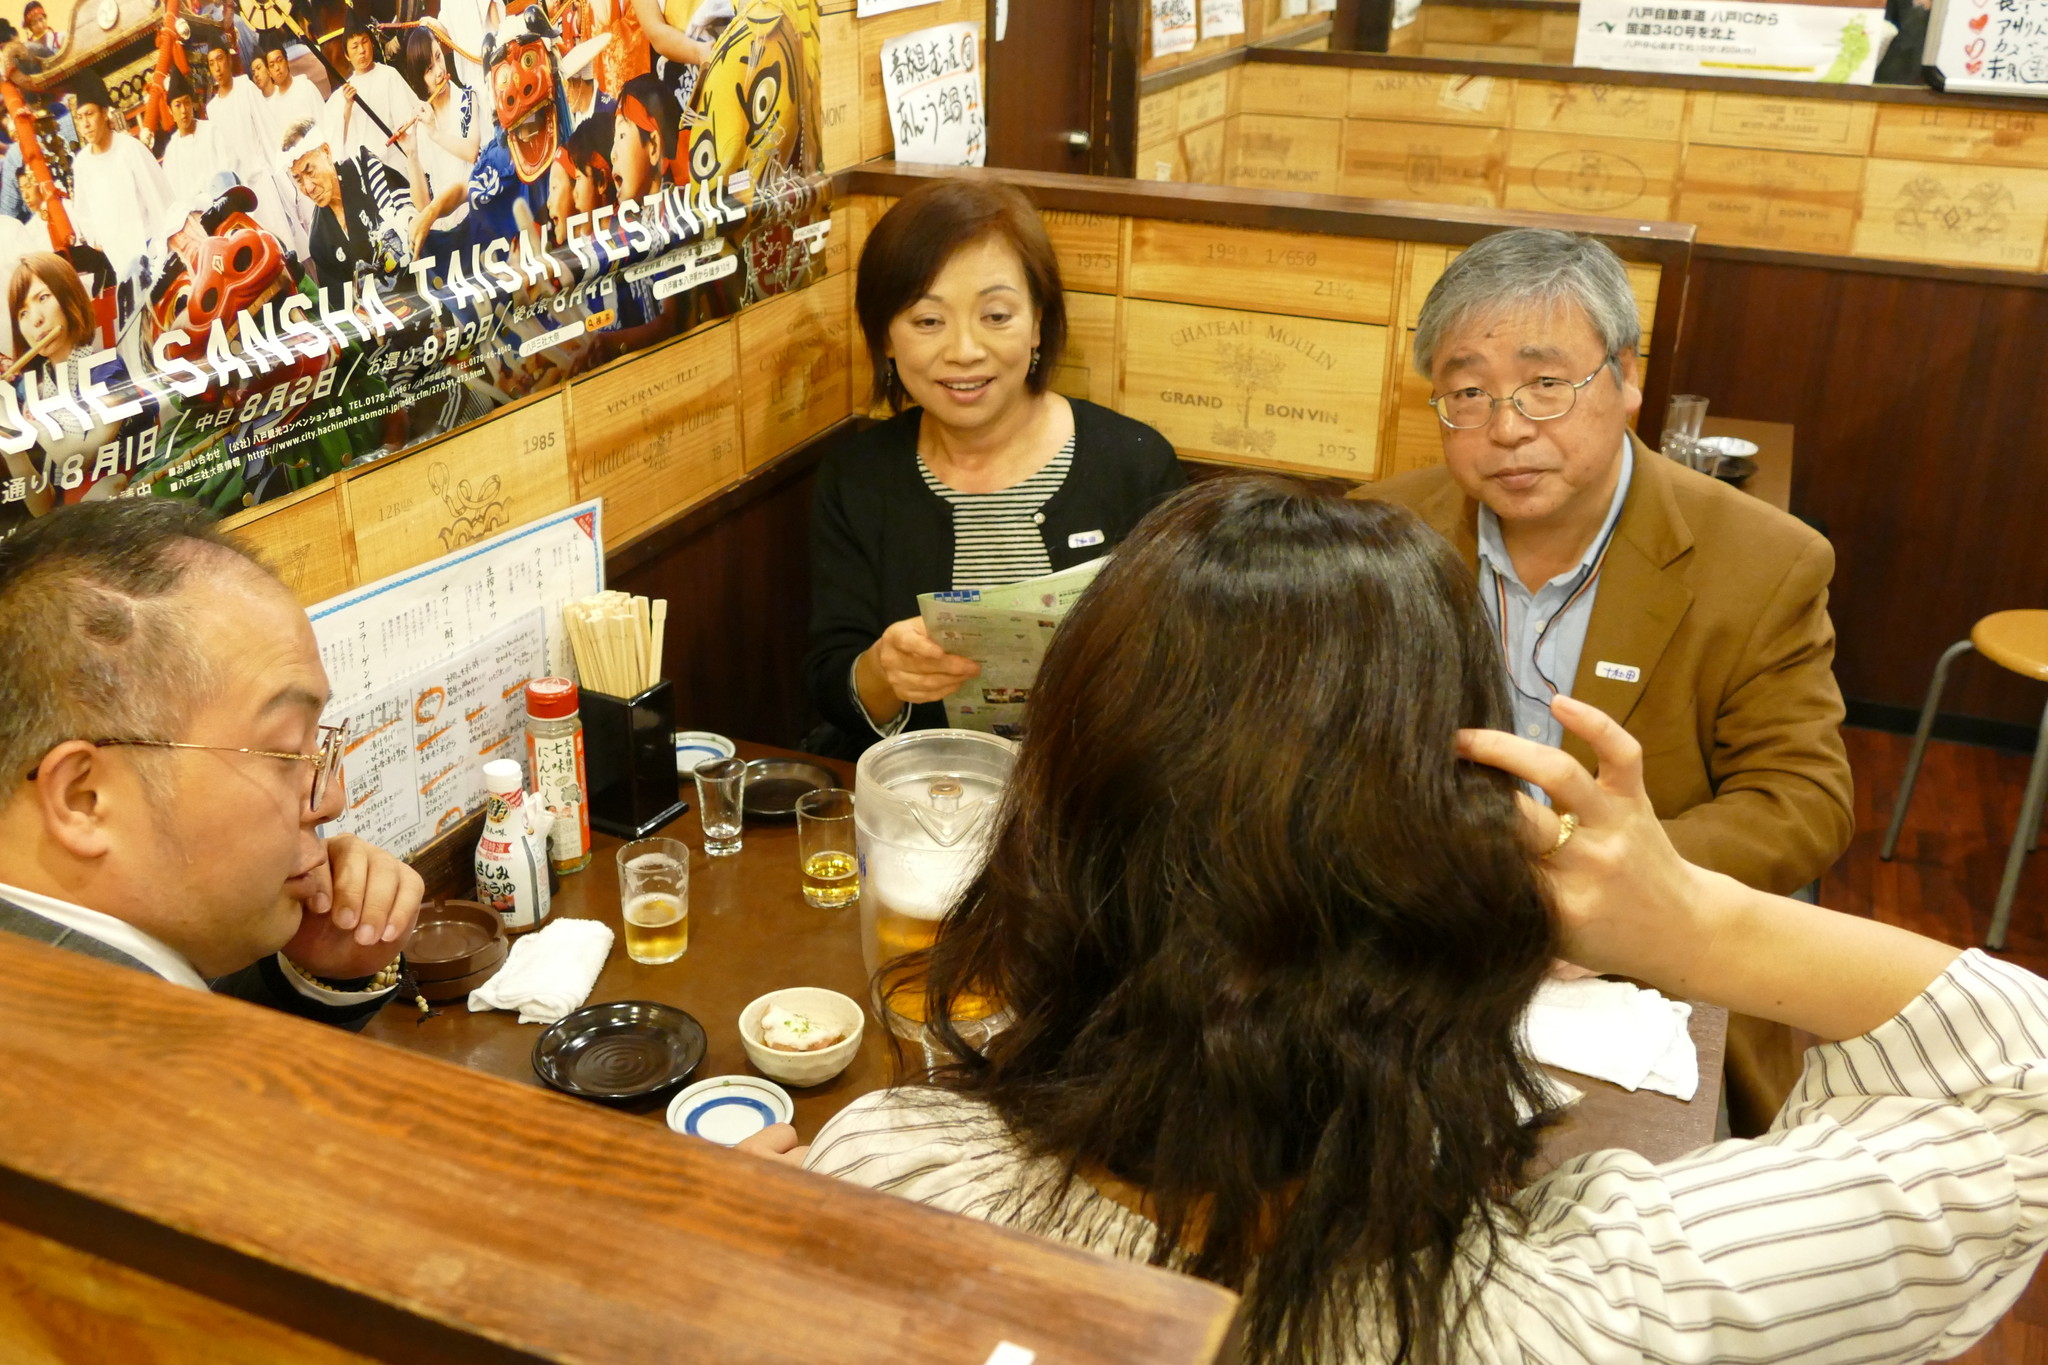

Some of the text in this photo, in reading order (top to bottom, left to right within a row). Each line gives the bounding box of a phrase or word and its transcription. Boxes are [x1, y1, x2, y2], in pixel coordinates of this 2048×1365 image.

[1077, 253, 1112, 269] 1975
[152, 271, 405, 398] SANSHA
[408, 223, 562, 317] TAISAI
[566, 176, 747, 271] FESTIVAL
[1170, 319, 1338, 371] CHATEAU MOULIN
[61, 425, 159, 490] 8月1日
[195, 407, 234, 433] 中日
[238, 366, 339, 423] 8月2日
[422, 313, 494, 367] 8月3日
[1160, 390, 1223, 410] GRAND
[523, 432, 555, 455] 1985
[1318, 443, 1356, 462] 1975
[551, 742, 566, 773] 七味
[537, 746, 553, 804] にんにく
[477, 860, 510, 881] さしみ
